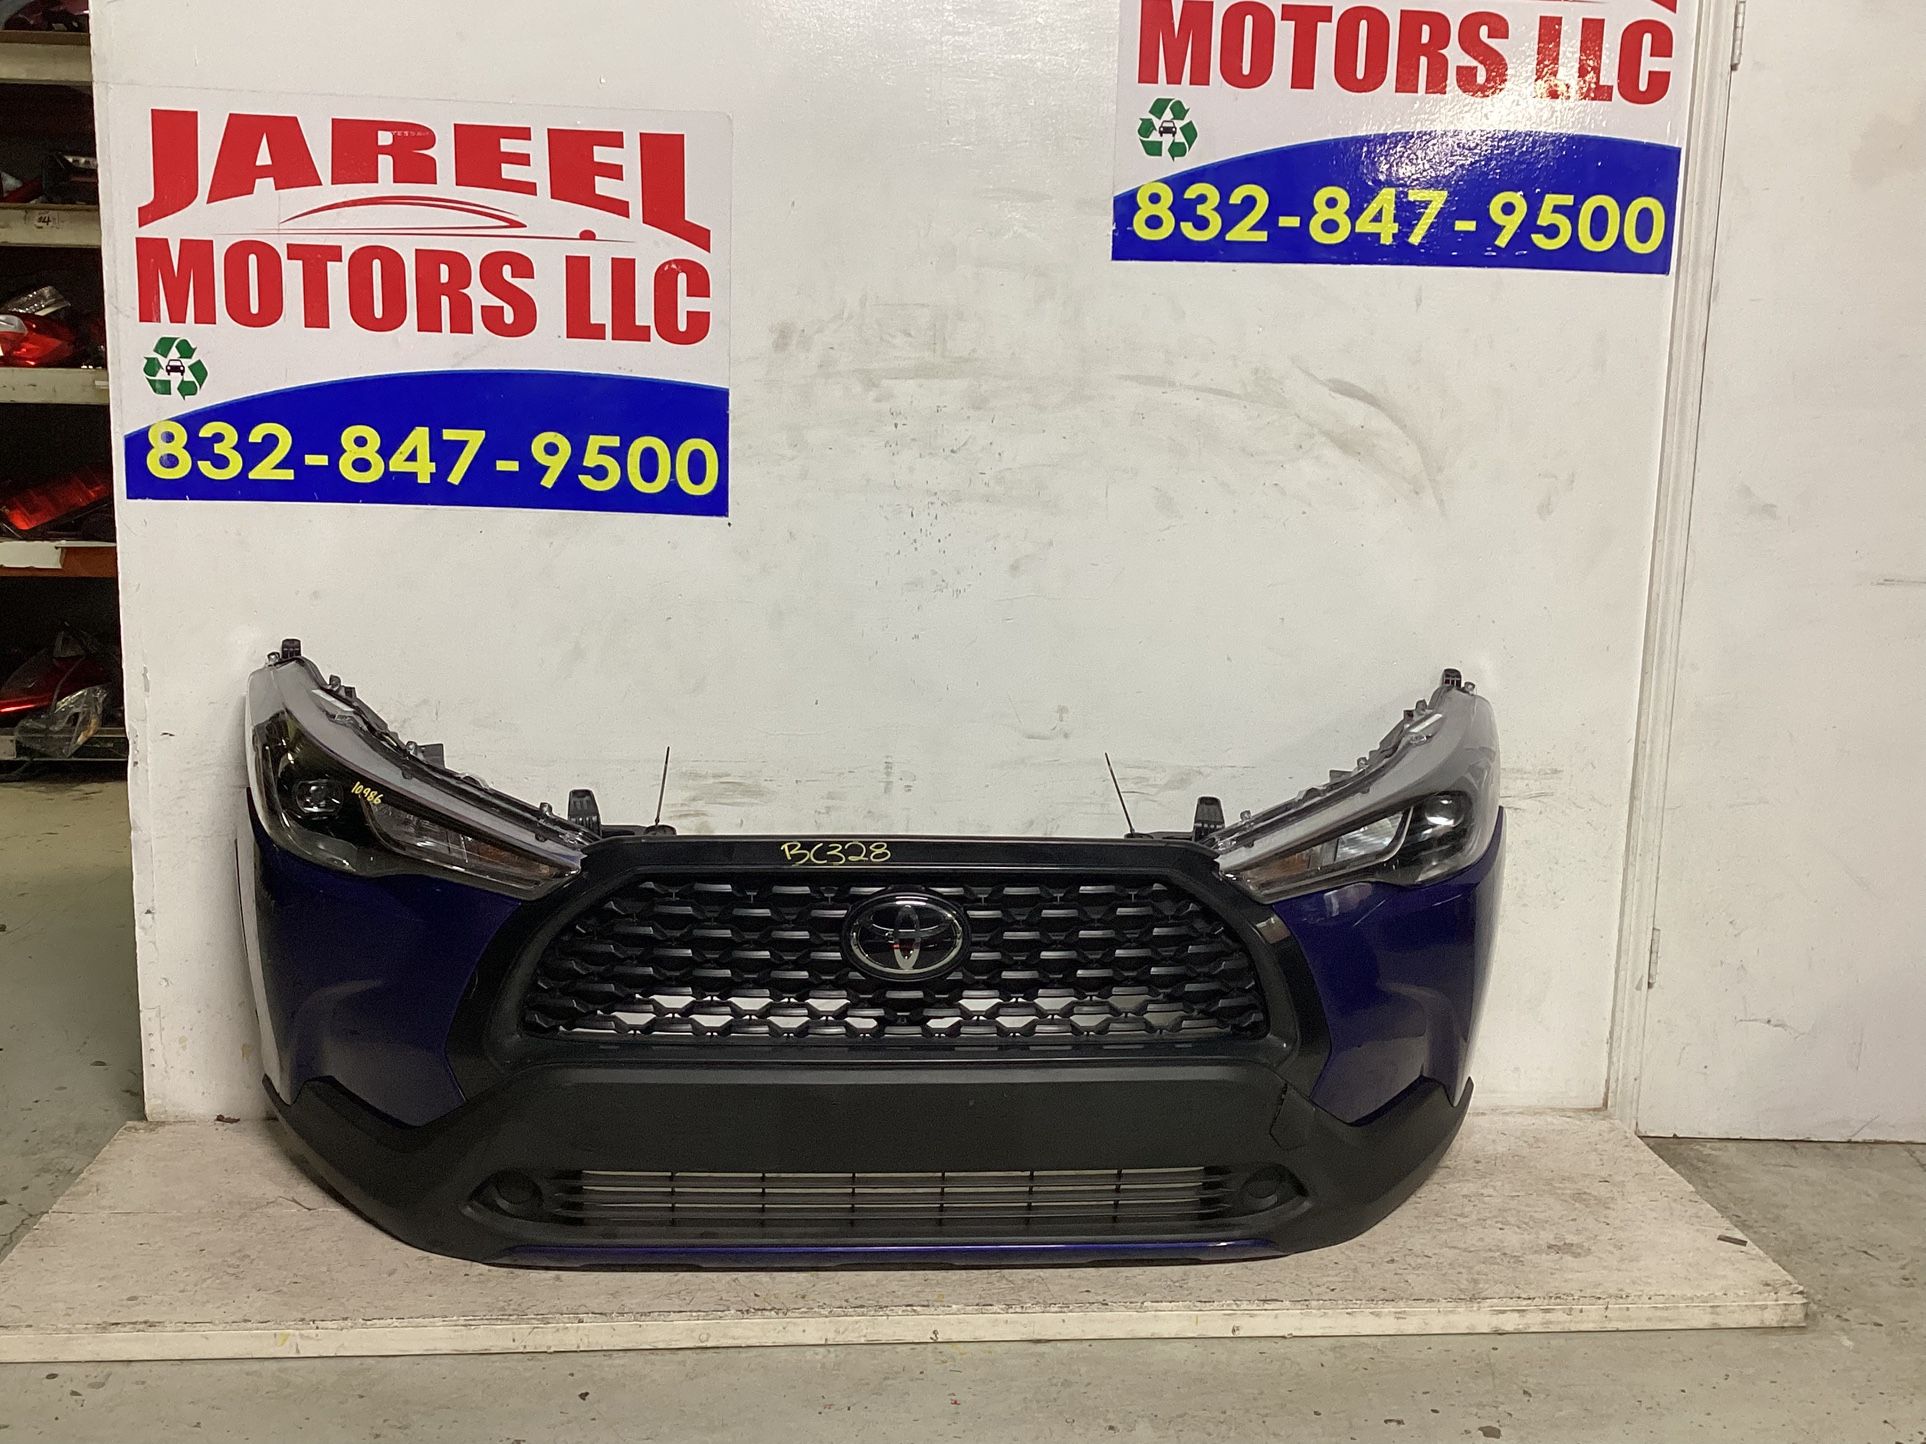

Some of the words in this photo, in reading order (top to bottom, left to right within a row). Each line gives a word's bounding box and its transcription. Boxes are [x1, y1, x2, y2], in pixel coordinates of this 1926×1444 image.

[1138, 0, 1509, 98] MOTORS
[1534, 15, 1674, 105] LLC
[137, 107, 711, 253] JAREEL
[1132, 180, 1666, 254] 832-847-9500
[135, 236, 537, 339] MOTORS
[565, 255, 712, 346] LLC
[147, 419, 719, 496] 832-847-9500
[351, 781, 384, 805] 10986
[780, 841, 891, 866] BC328
